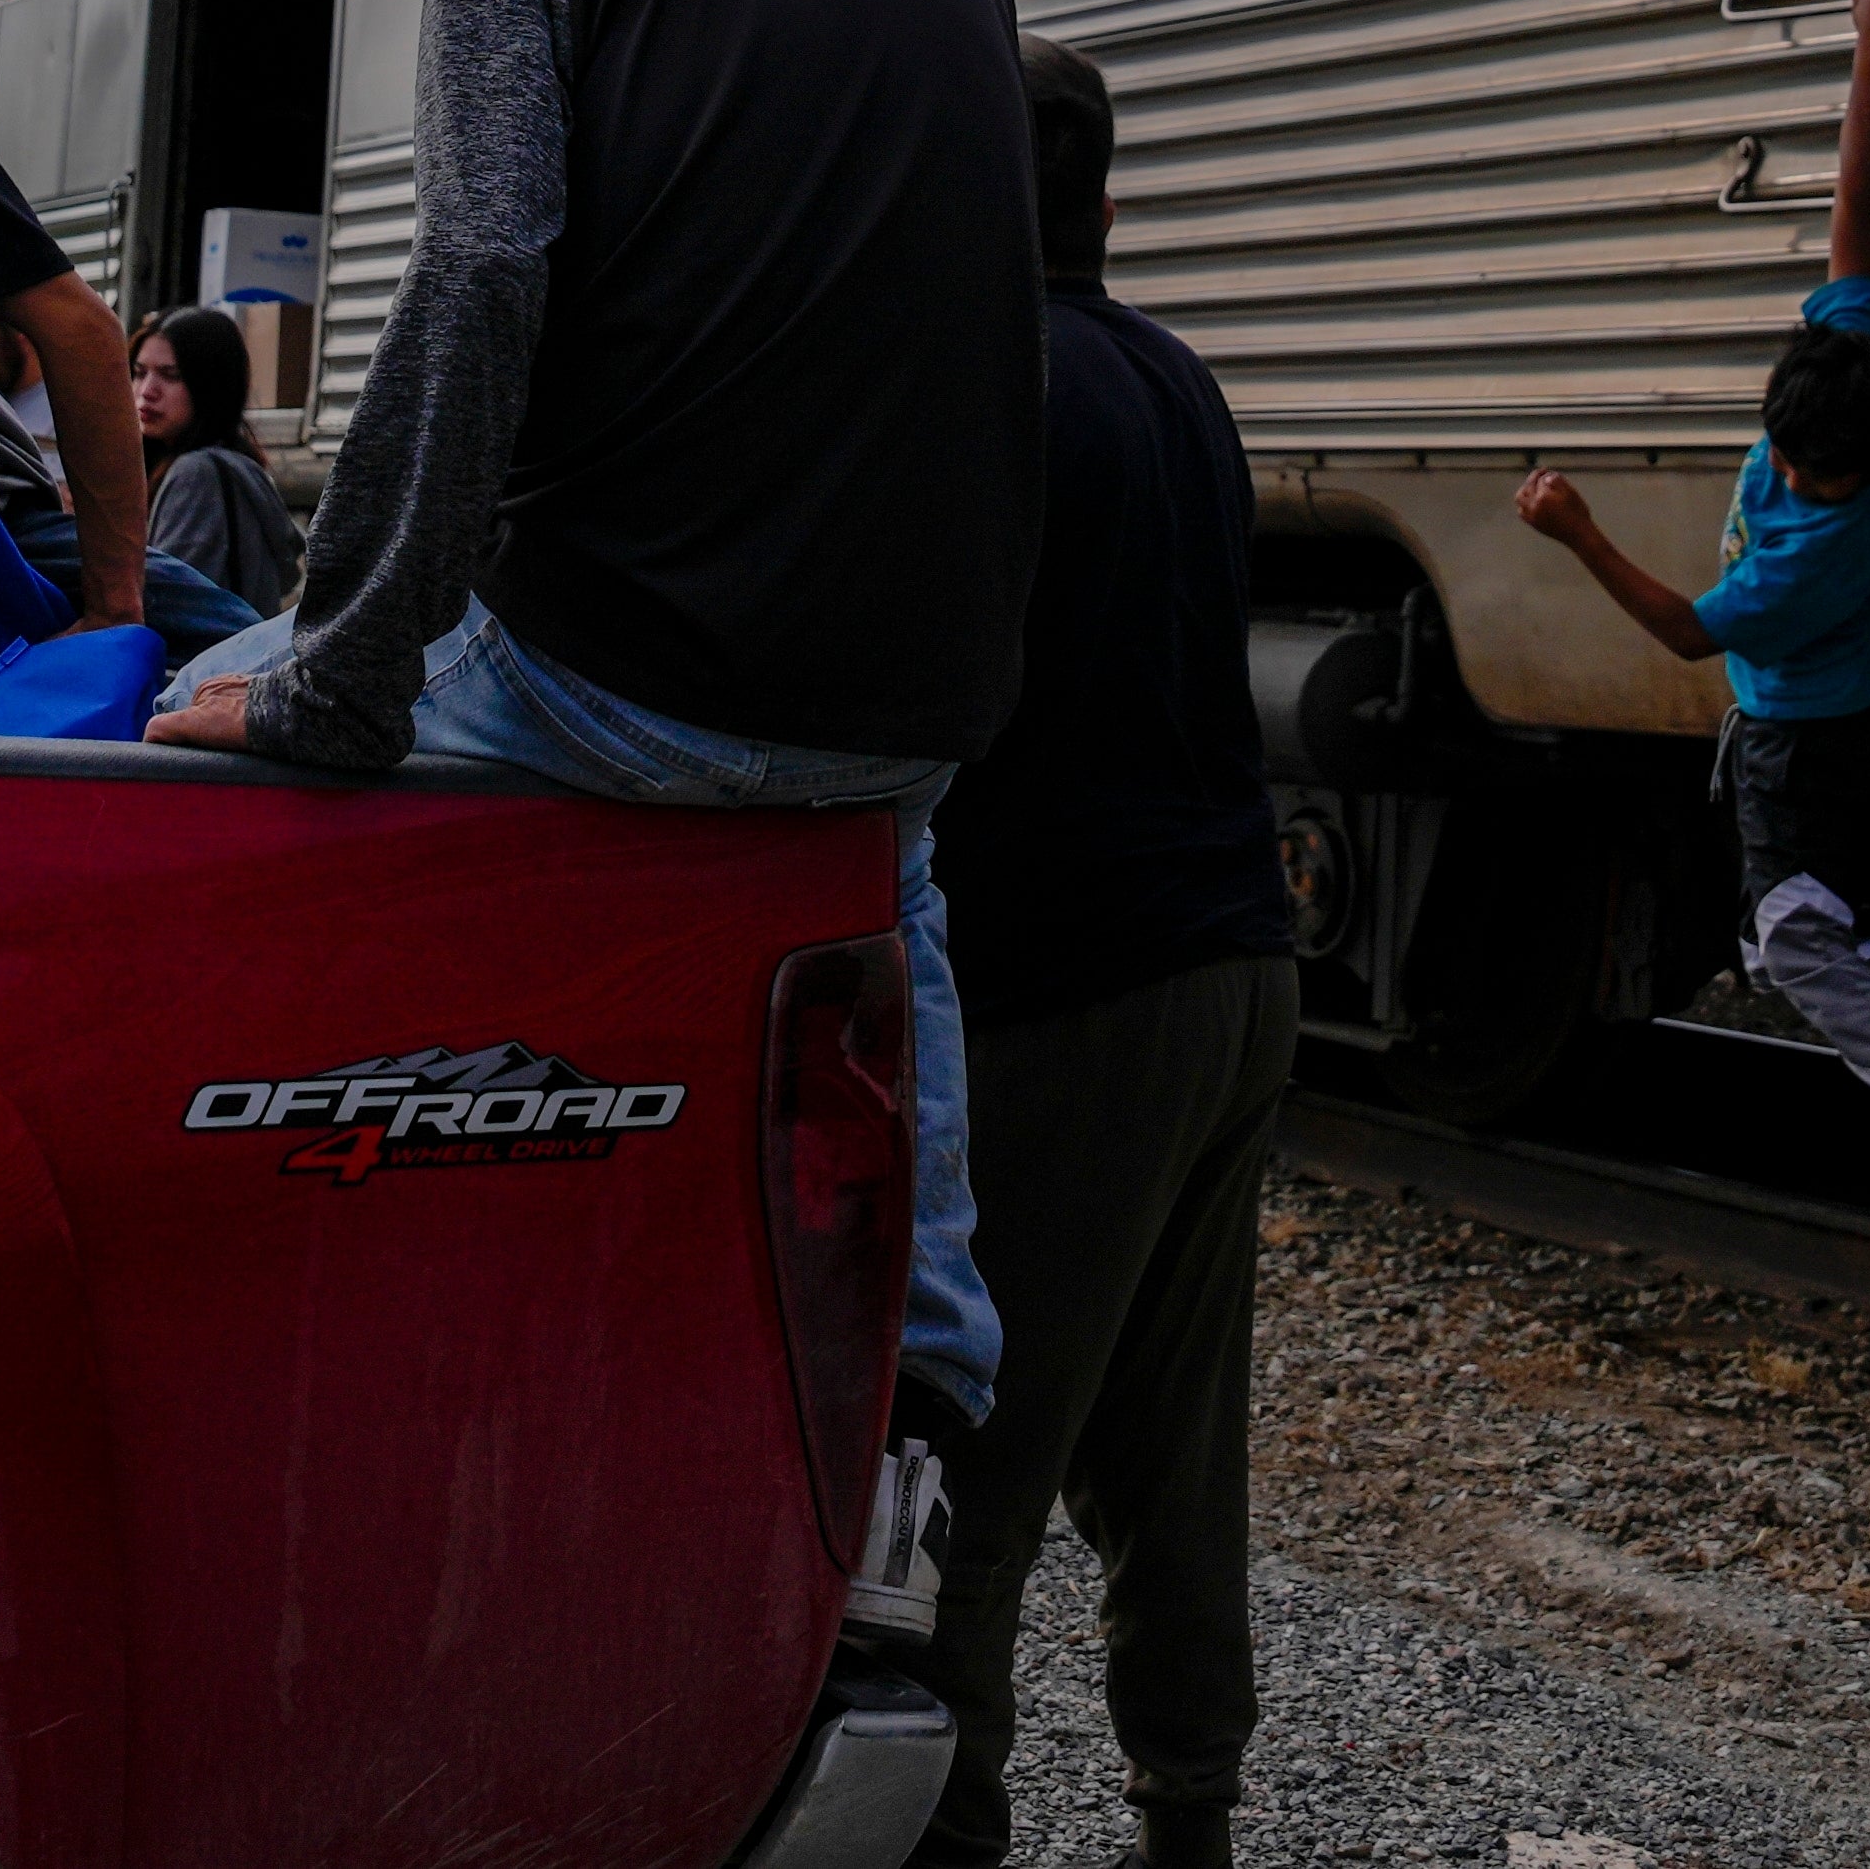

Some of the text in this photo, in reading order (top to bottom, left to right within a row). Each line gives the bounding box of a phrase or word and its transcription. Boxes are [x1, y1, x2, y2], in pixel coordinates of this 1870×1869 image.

[281, 1125, 610, 1186] 4 WHEEL DRIVE
